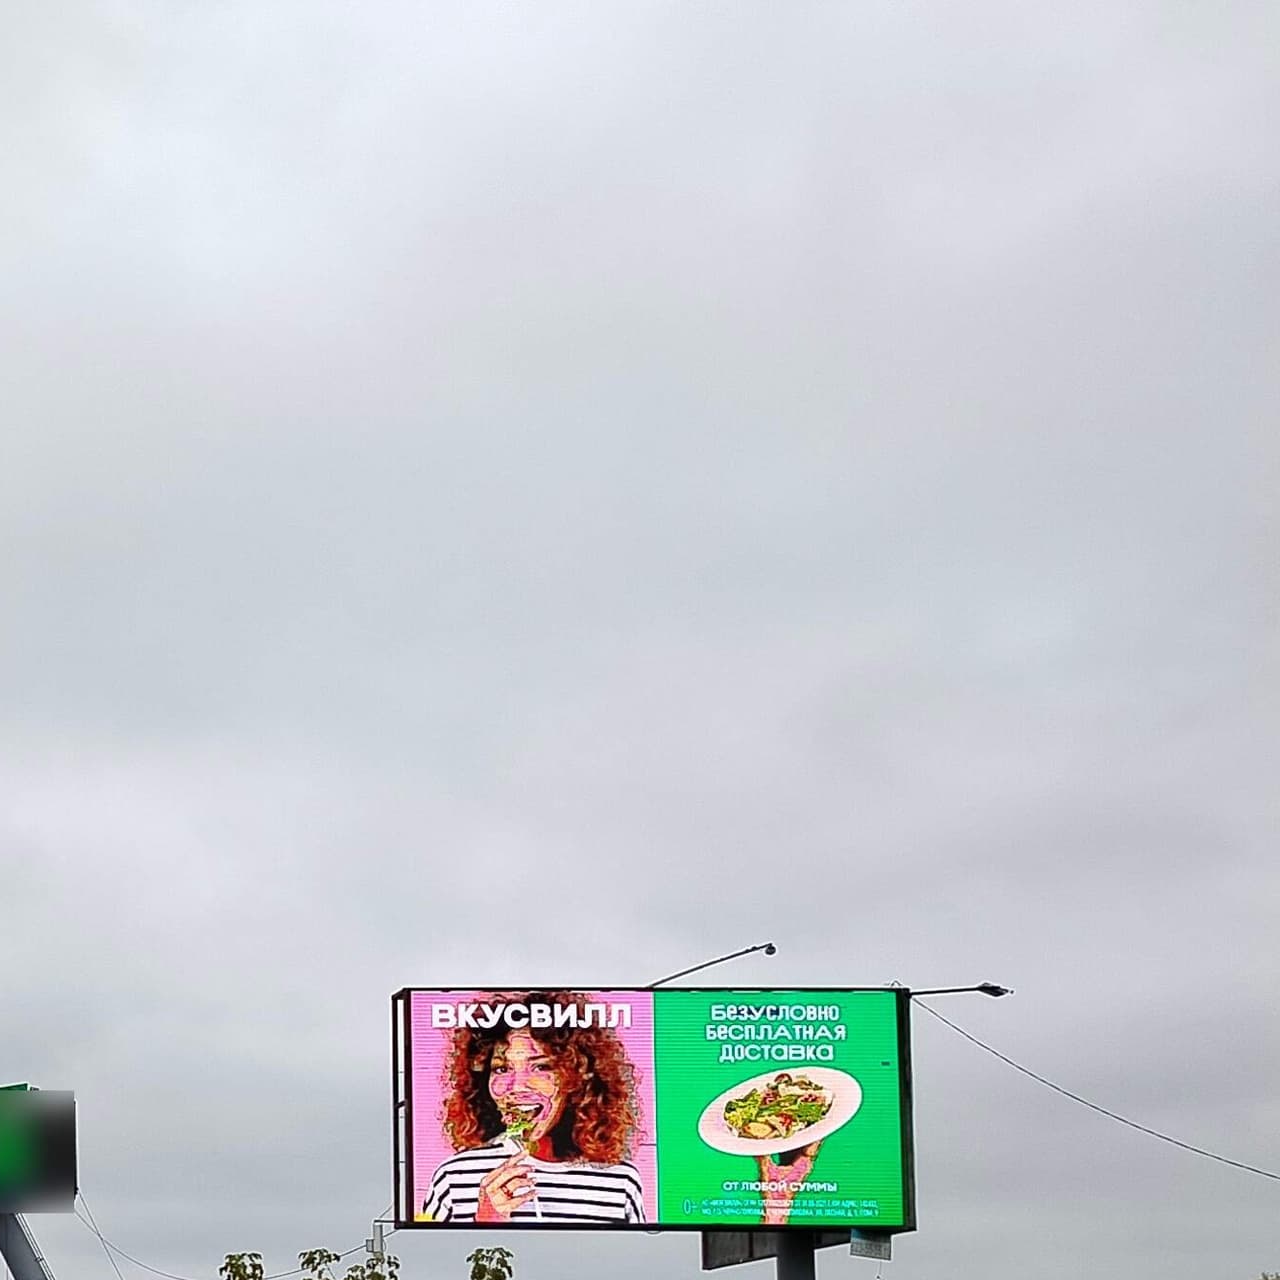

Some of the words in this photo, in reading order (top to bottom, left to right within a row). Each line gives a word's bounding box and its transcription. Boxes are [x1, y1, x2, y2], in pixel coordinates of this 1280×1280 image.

[431, 1003, 632, 1028] ВКУСВИЛЛ
[723, 1181, 739, 1191] ОТ
[741, 1180, 787, 1192] ЛЮБОЙ
[789, 1182, 838, 1192] СУММЫ
